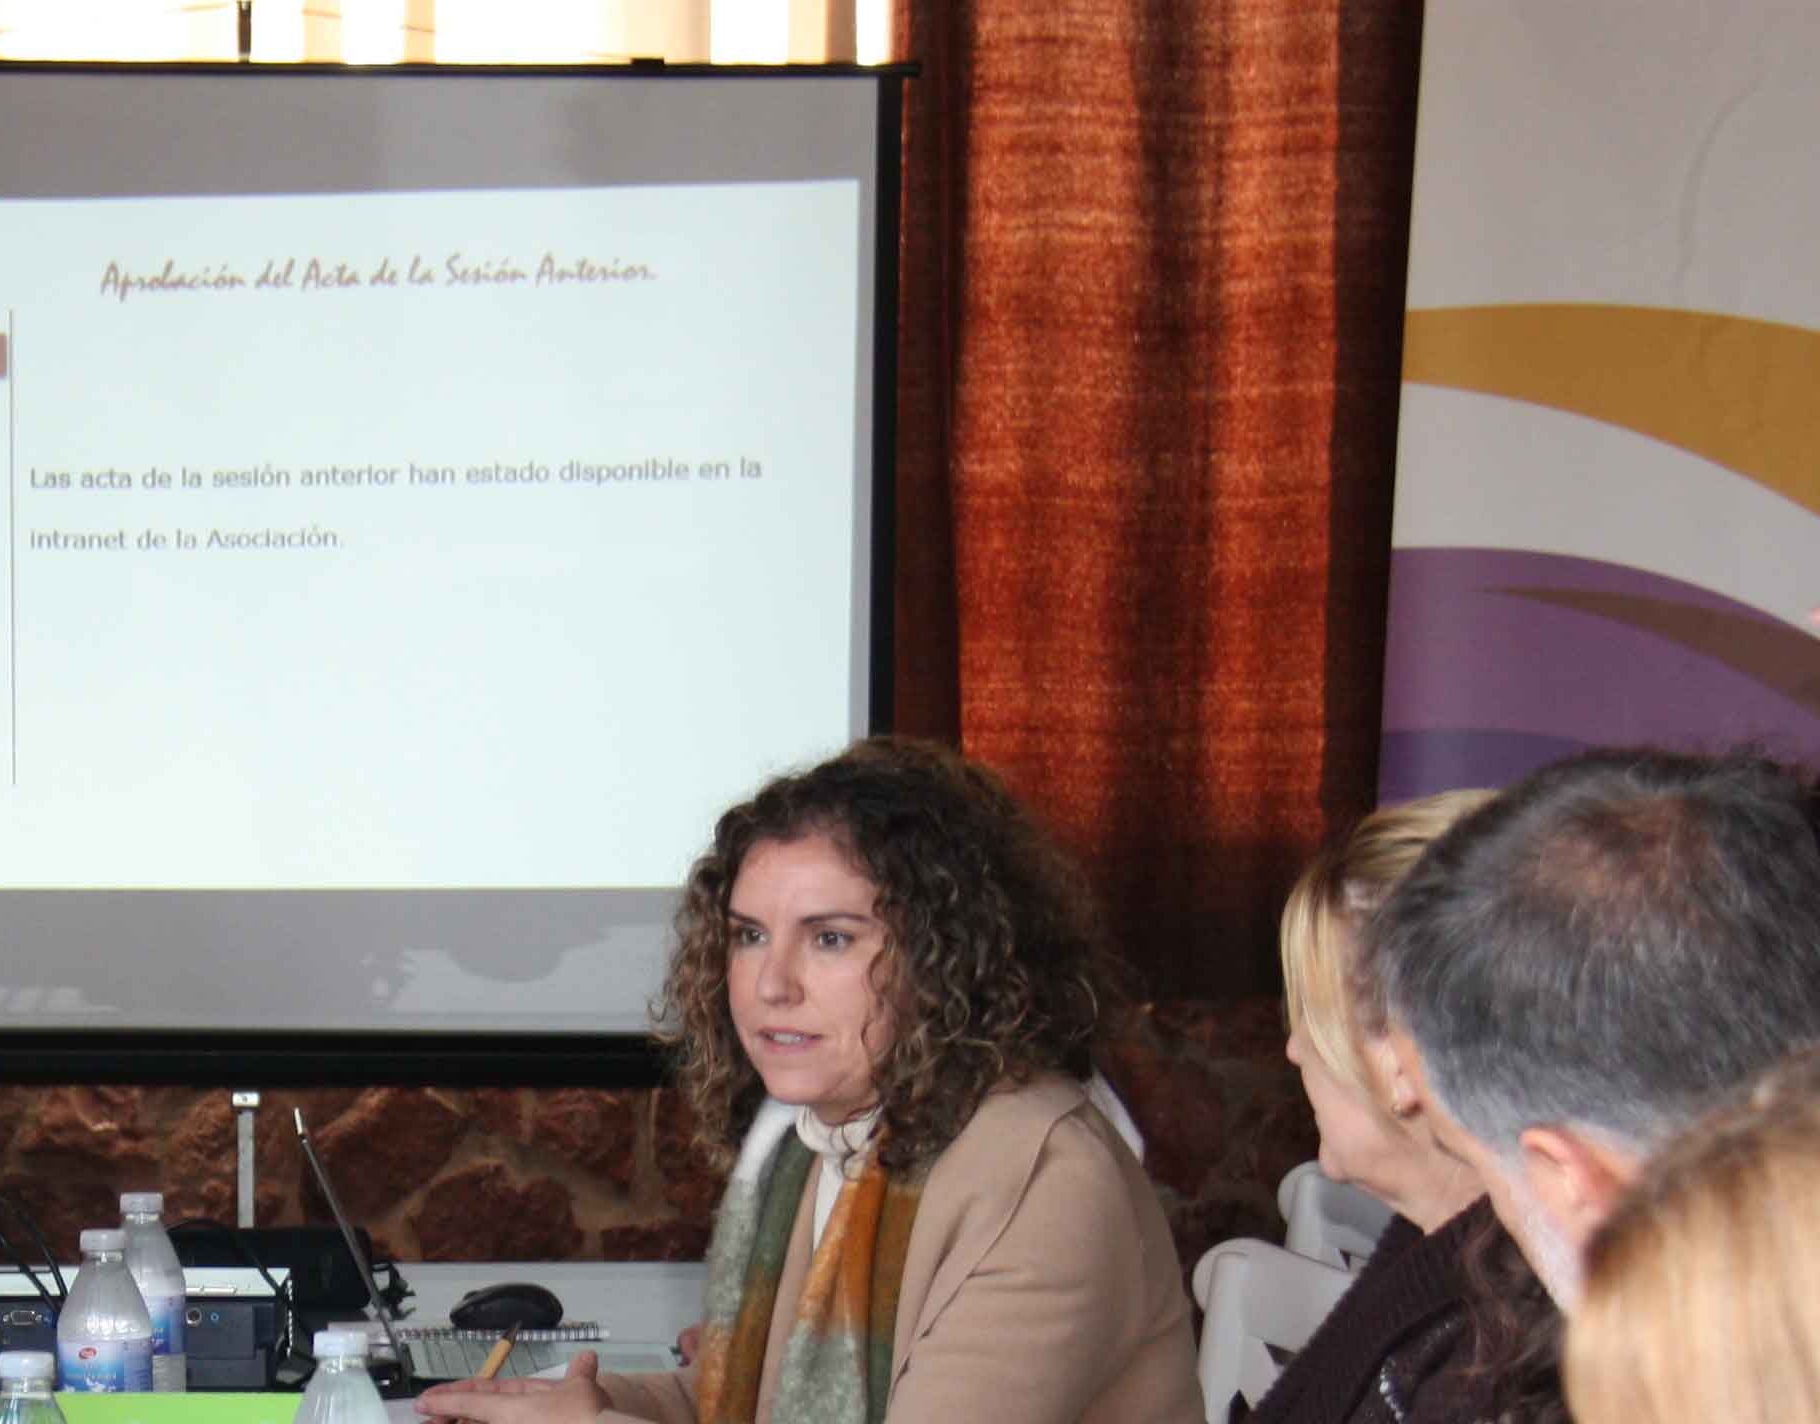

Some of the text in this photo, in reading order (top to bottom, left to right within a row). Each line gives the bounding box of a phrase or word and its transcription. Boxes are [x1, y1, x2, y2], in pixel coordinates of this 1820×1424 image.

[99, 260, 245, 301] Aprobación
[254, 258, 296, 289] del
[300, 258, 360, 292] Acta
[369, 257, 398, 288] de
[406, 256, 435, 286] la
[445, 251, 528, 287] Sesión
[30, 456, 762, 489] Las acta de la sesión anterior han estado disponible en la
[30, 528, 127, 550] intranet
[136, 529, 167, 550] de
[176, 528, 197, 550] la
